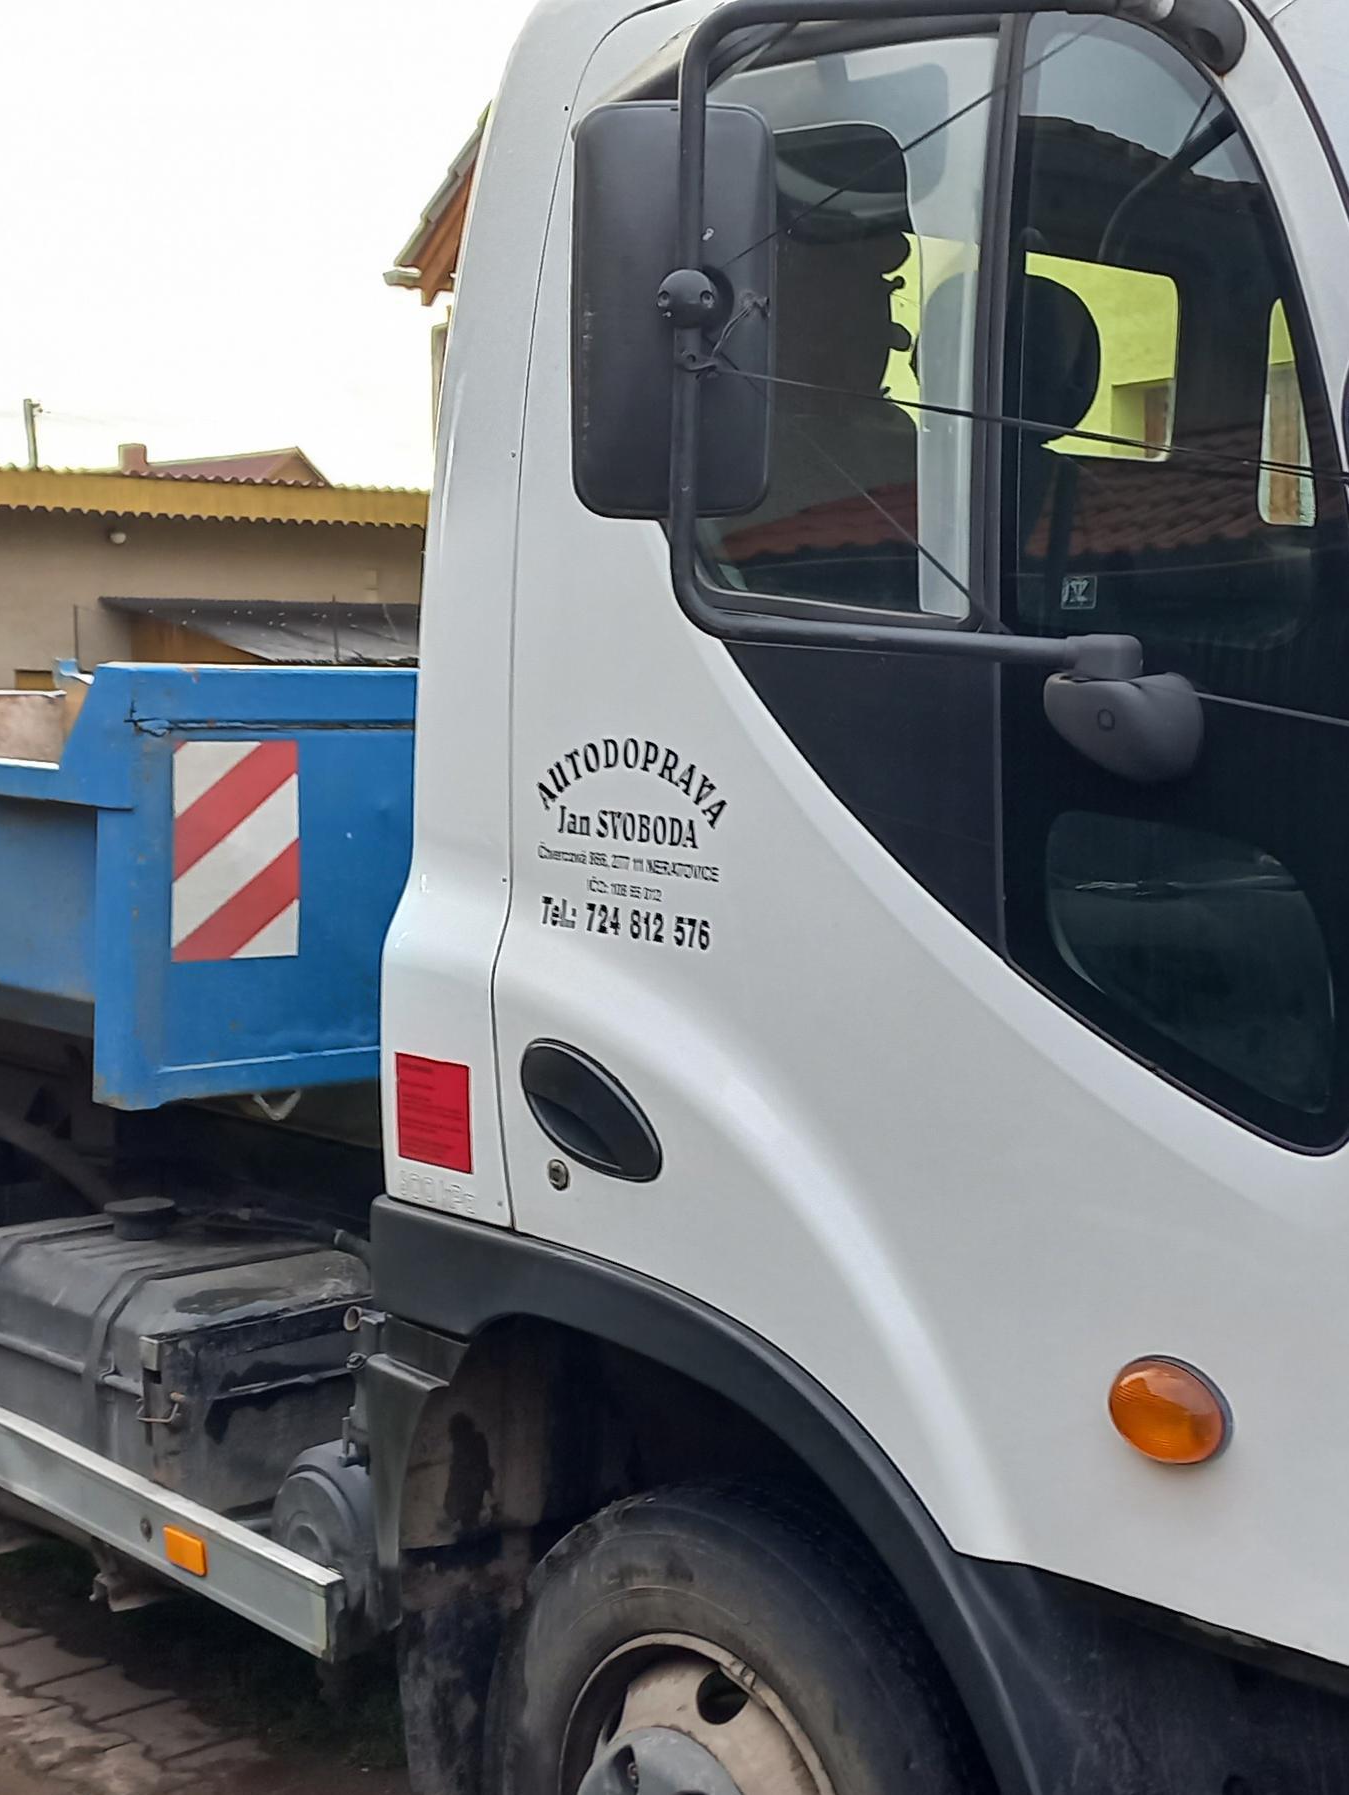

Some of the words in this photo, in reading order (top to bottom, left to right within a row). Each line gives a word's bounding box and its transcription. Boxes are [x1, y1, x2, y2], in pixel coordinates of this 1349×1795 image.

[536, 737, 728, 830] AUTODOPRAVA
[558, 805, 590, 837] Jan
[596, 809, 699, 849] SVOBODA
[586, 903, 620, 935] 724
[630, 910, 664, 943] 812
[673, 916, 710, 951] 576
